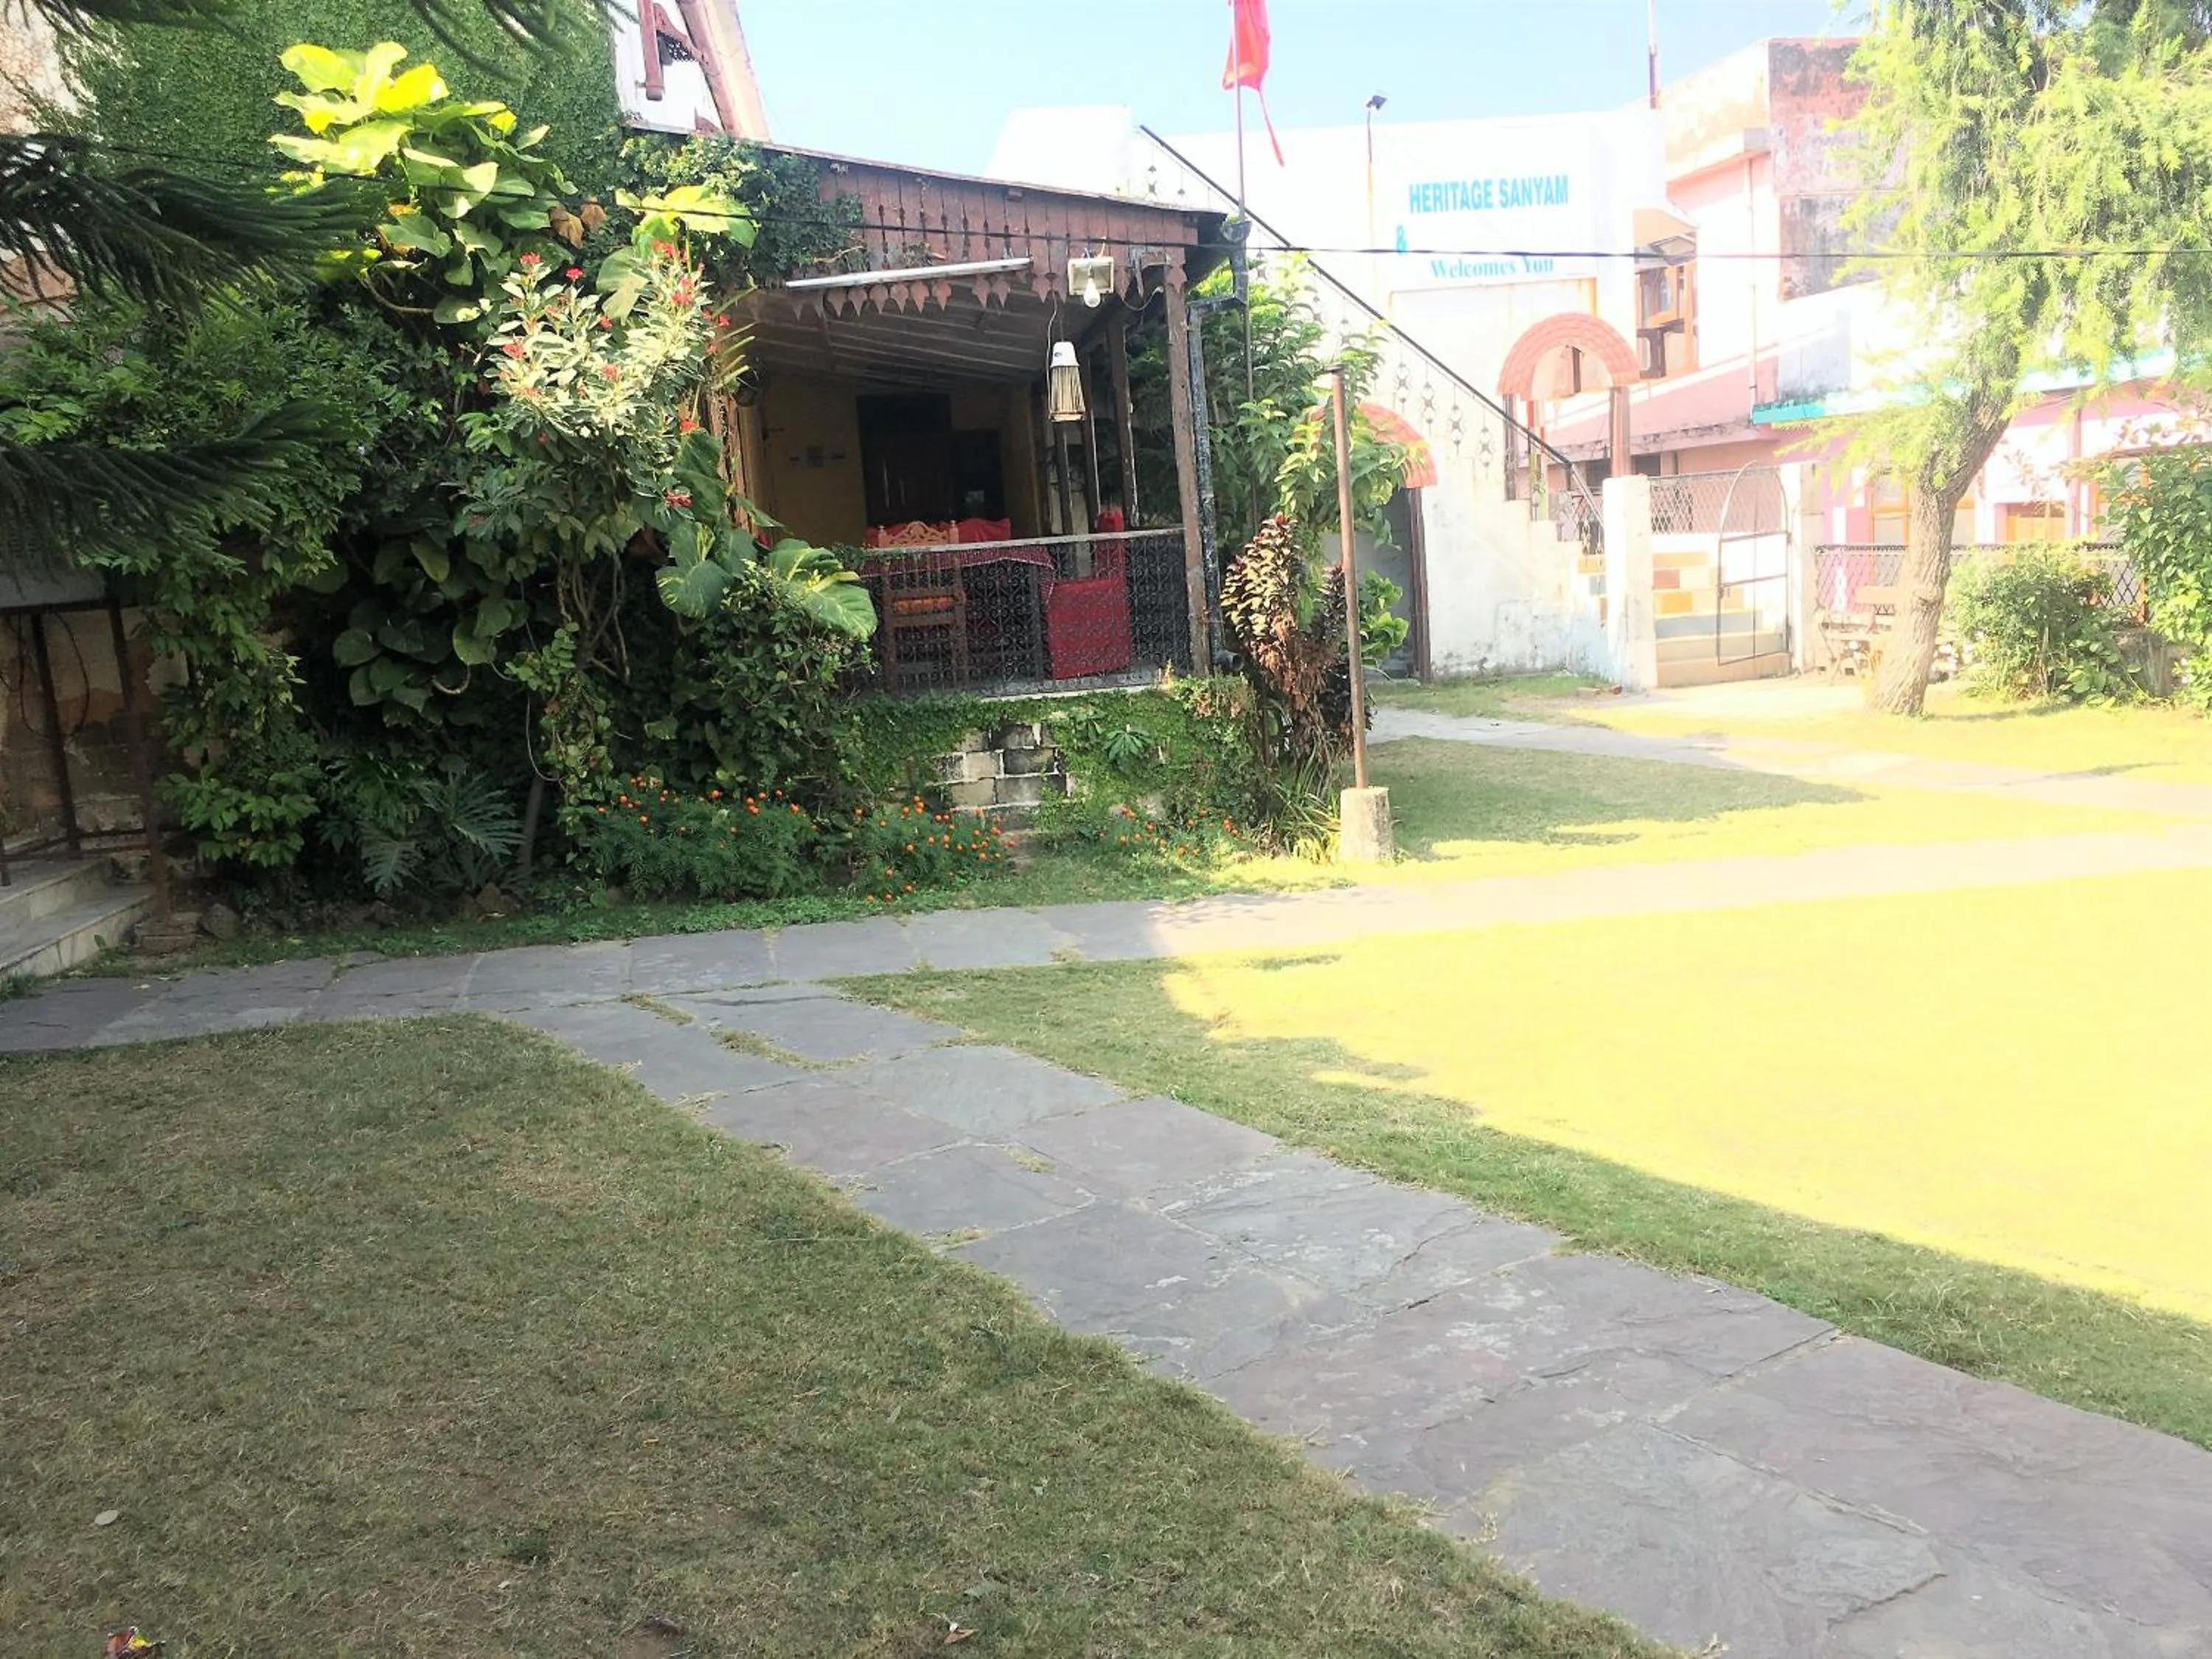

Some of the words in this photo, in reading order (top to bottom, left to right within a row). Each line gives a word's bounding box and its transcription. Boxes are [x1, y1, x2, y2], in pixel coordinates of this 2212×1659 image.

[1408, 178, 1493, 214] HERITAGE
[1498, 175, 1569, 208] SANYAM
[1430, 258, 1516, 279] Welcomes
[1521, 255, 1554, 274] You
